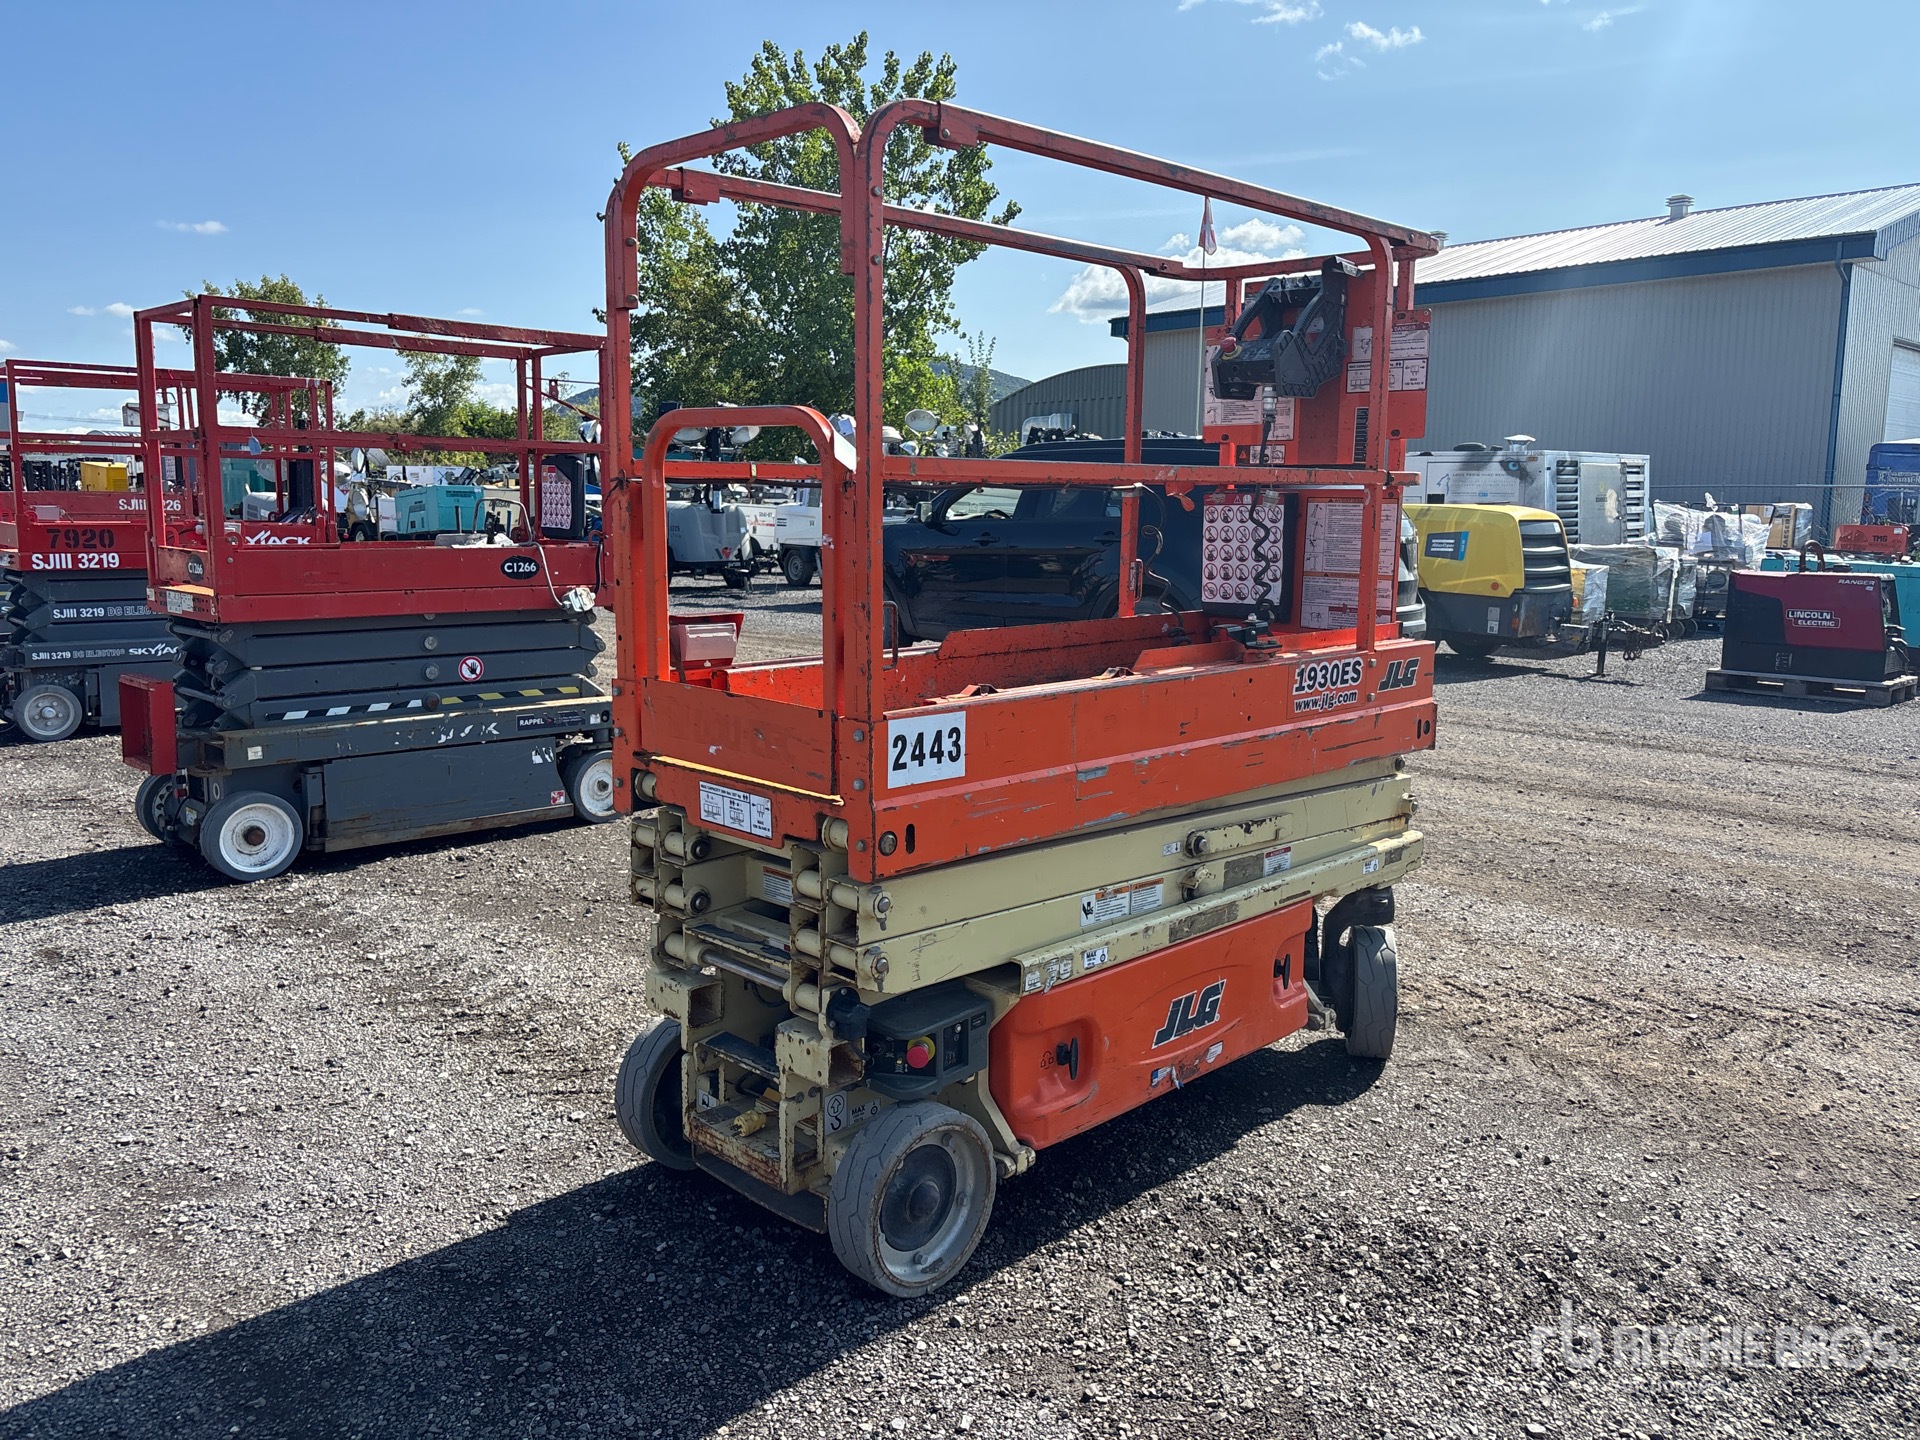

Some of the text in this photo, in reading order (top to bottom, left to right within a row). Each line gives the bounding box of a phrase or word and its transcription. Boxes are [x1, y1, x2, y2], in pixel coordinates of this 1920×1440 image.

[119, 499, 146, 510] SJIII
[47, 529, 115, 549] 7920
[32, 553, 120, 570] SJIII 3219
[504, 562, 537, 573] C1266
[53, 608, 77, 618] SJIII
[80, 608, 104, 617] 3219
[107, 607, 122, 616] DC
[1788, 611, 1831, 620] LINCOLN
[32, 652, 50, 660] SJIII
[51, 651, 71, 659] 3219
[1293, 658, 1363, 694] 1930ES
[1378, 658, 1420, 692] JLG
[1294, 690, 1358, 711] www.jlg.com
[519, 719, 545, 727] RAPPEL
[892, 726, 962, 772] 2443
[1086, 951, 1097, 959] MAX
[1152, 979, 1227, 1049] JLG
[851, 1105, 866, 1116] MAX
